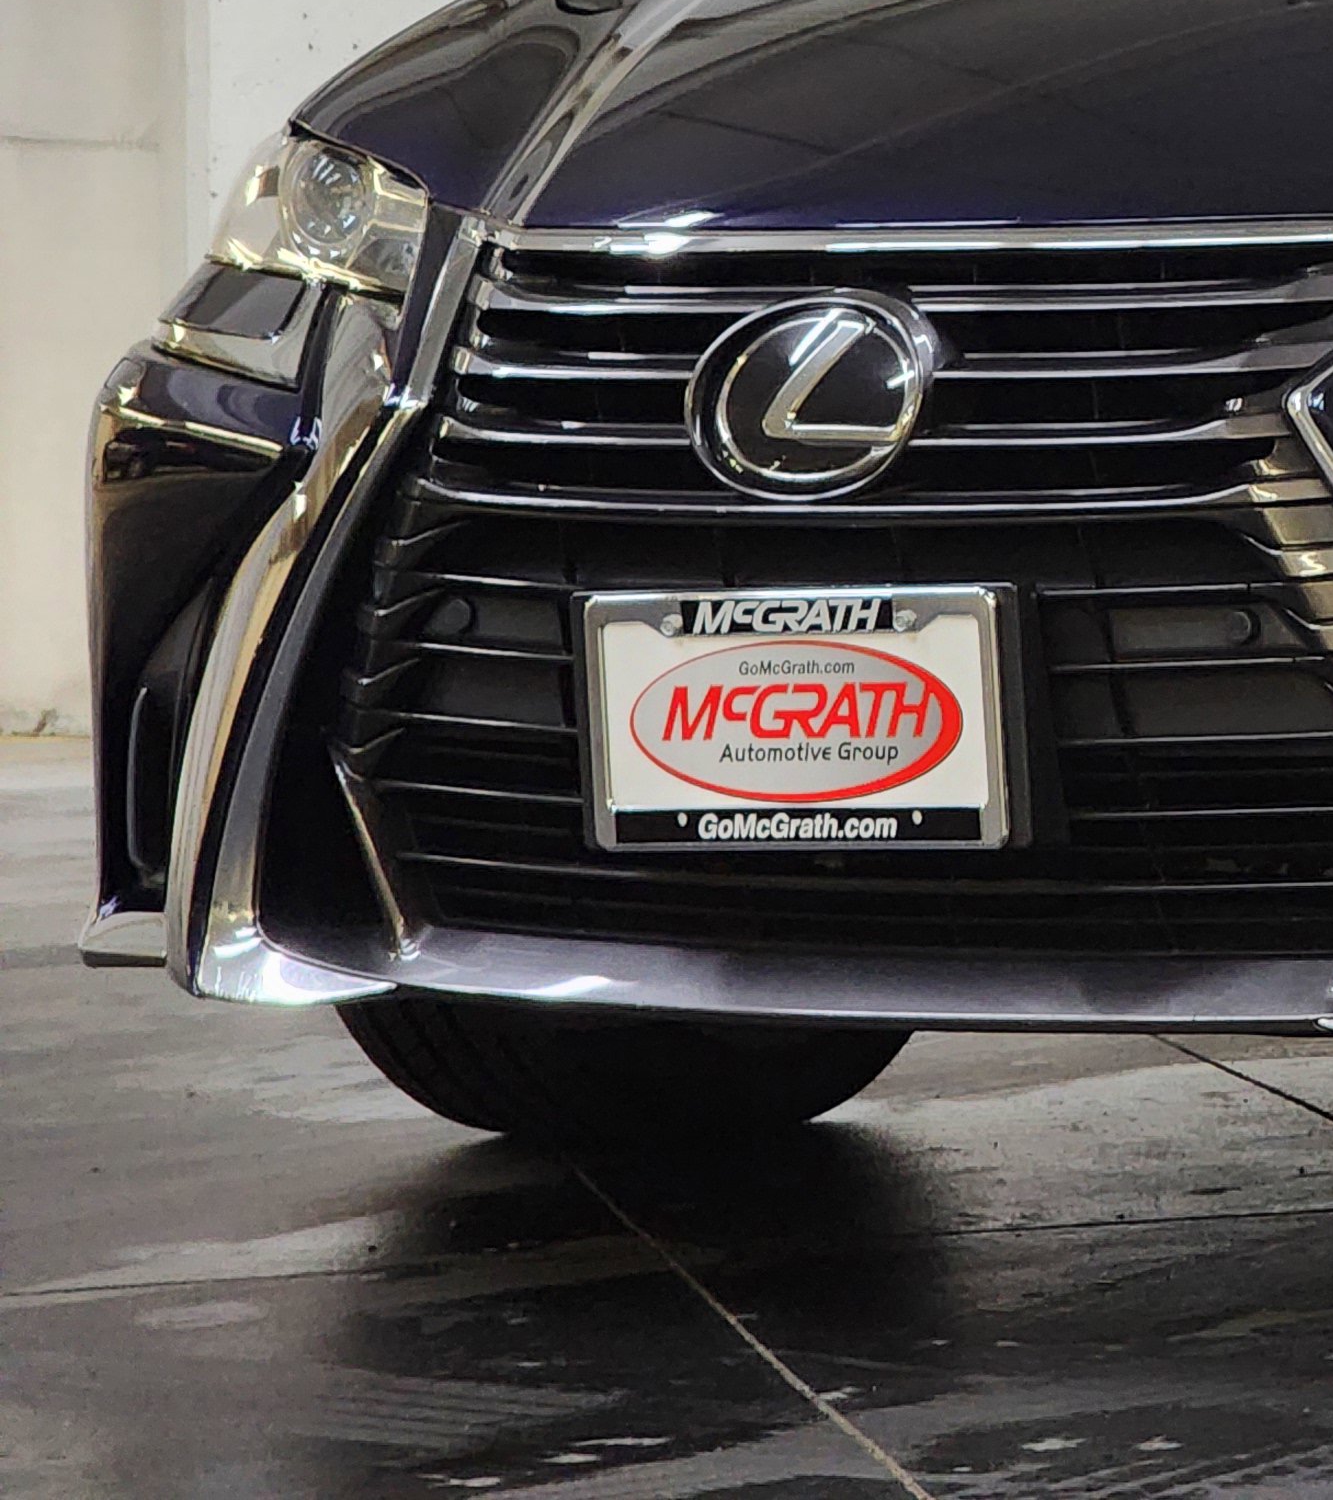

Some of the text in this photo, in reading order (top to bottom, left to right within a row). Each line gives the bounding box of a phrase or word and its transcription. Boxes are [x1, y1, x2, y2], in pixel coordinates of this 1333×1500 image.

[738, 659, 855, 676] GoMcGrath.com
[719, 741, 899, 766] Automotive Group
[698, 812, 898, 841] GoMcGrath.com
